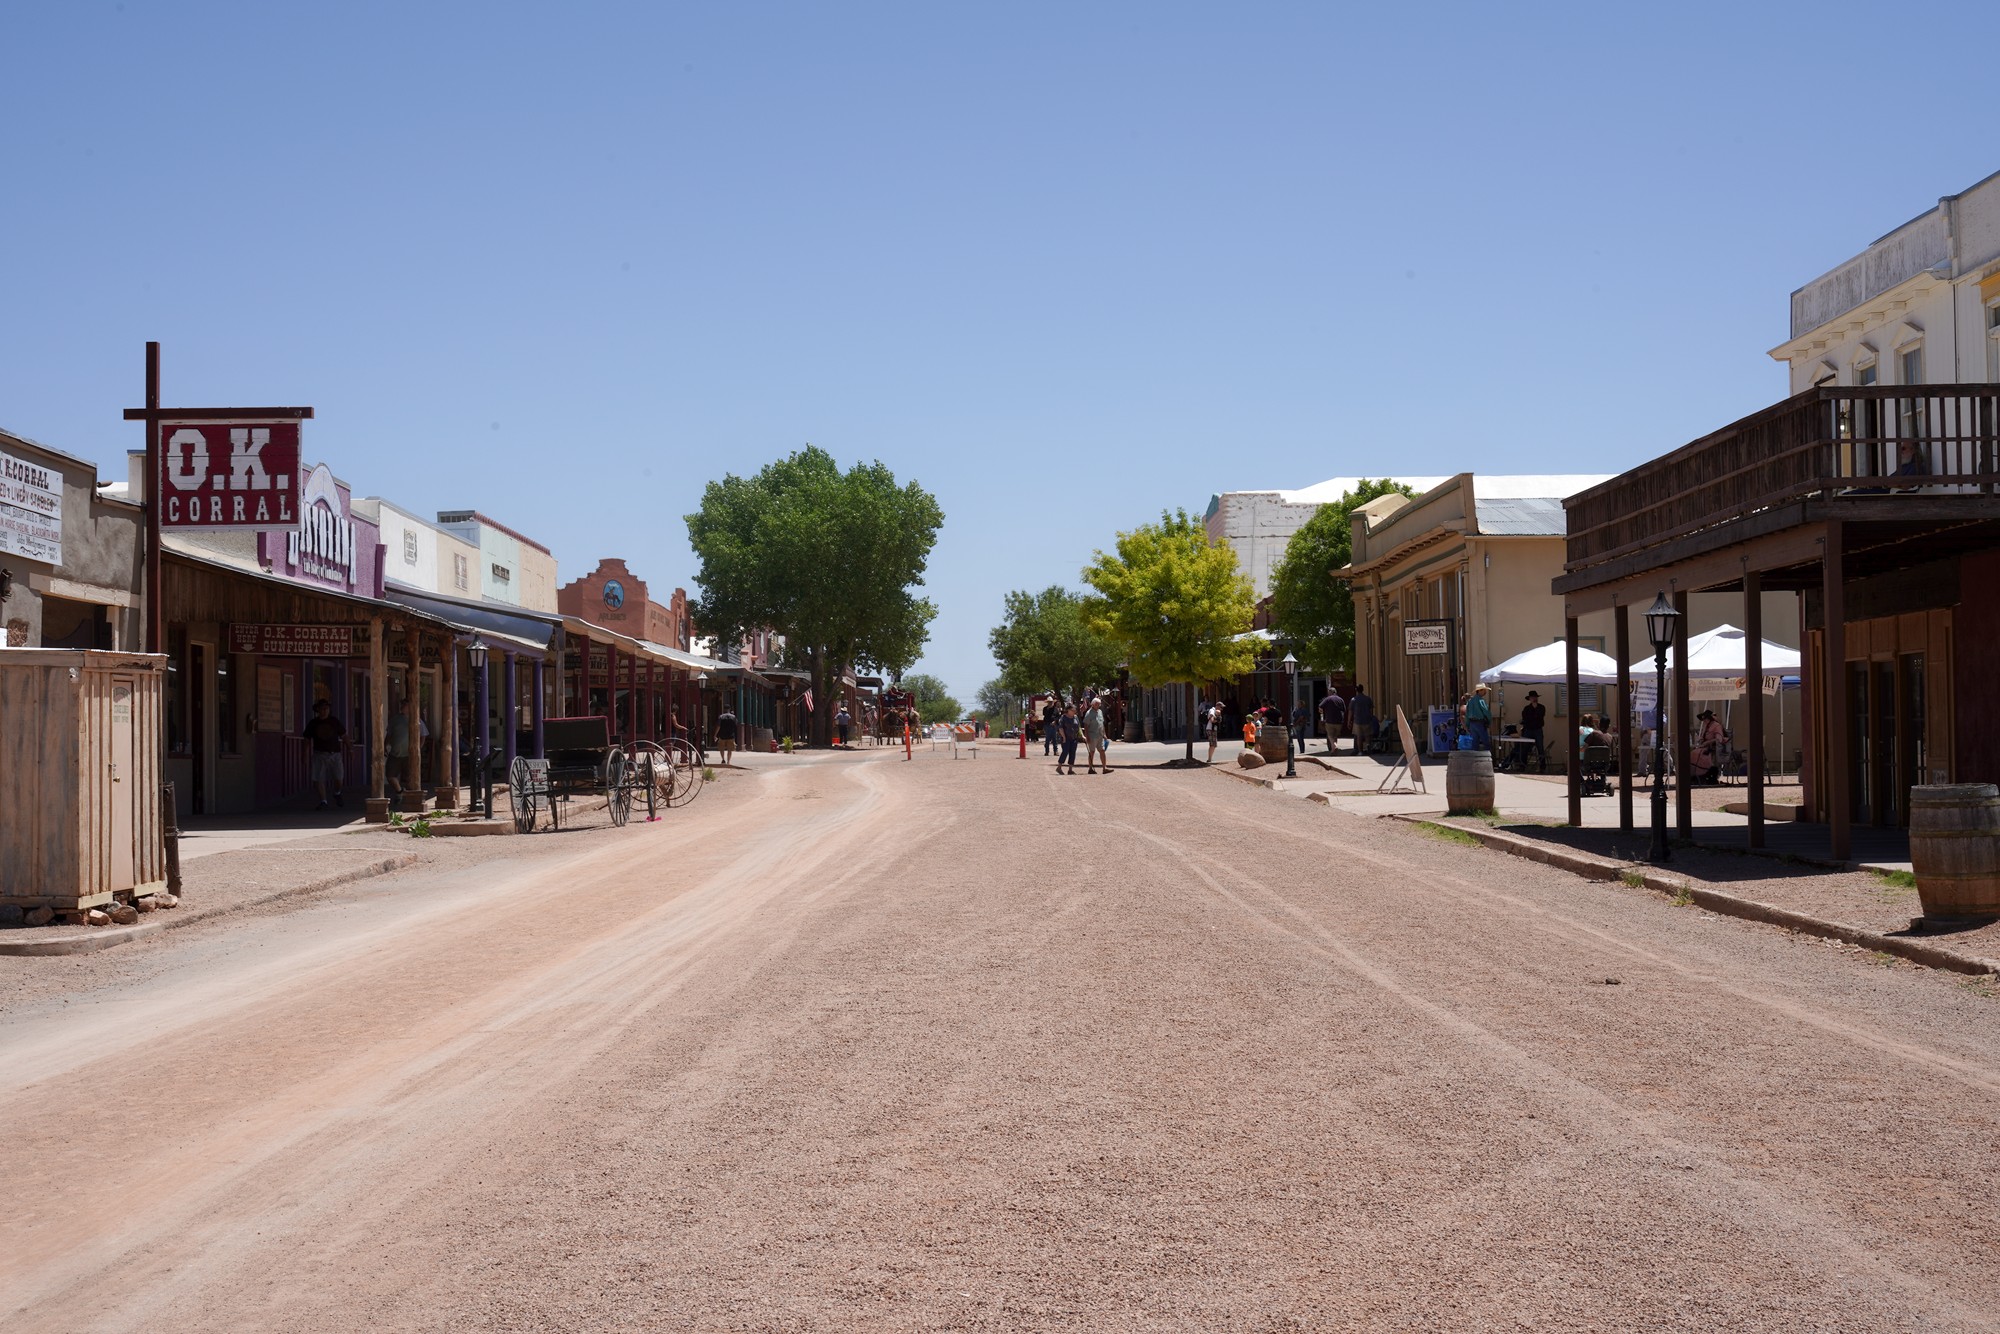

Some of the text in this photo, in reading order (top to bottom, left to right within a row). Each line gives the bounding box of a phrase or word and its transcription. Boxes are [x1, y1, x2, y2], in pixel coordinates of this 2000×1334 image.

[167, 428, 289, 491] O.K.
[168, 496, 292, 522] CORRAL
[235, 625, 259, 635] ENTER
[264, 627, 290, 639] O.K.
[294, 628, 348, 640] CORRAL
[263, 640, 320, 654] GUNFIGHT
[323, 642, 349, 654] SITE
